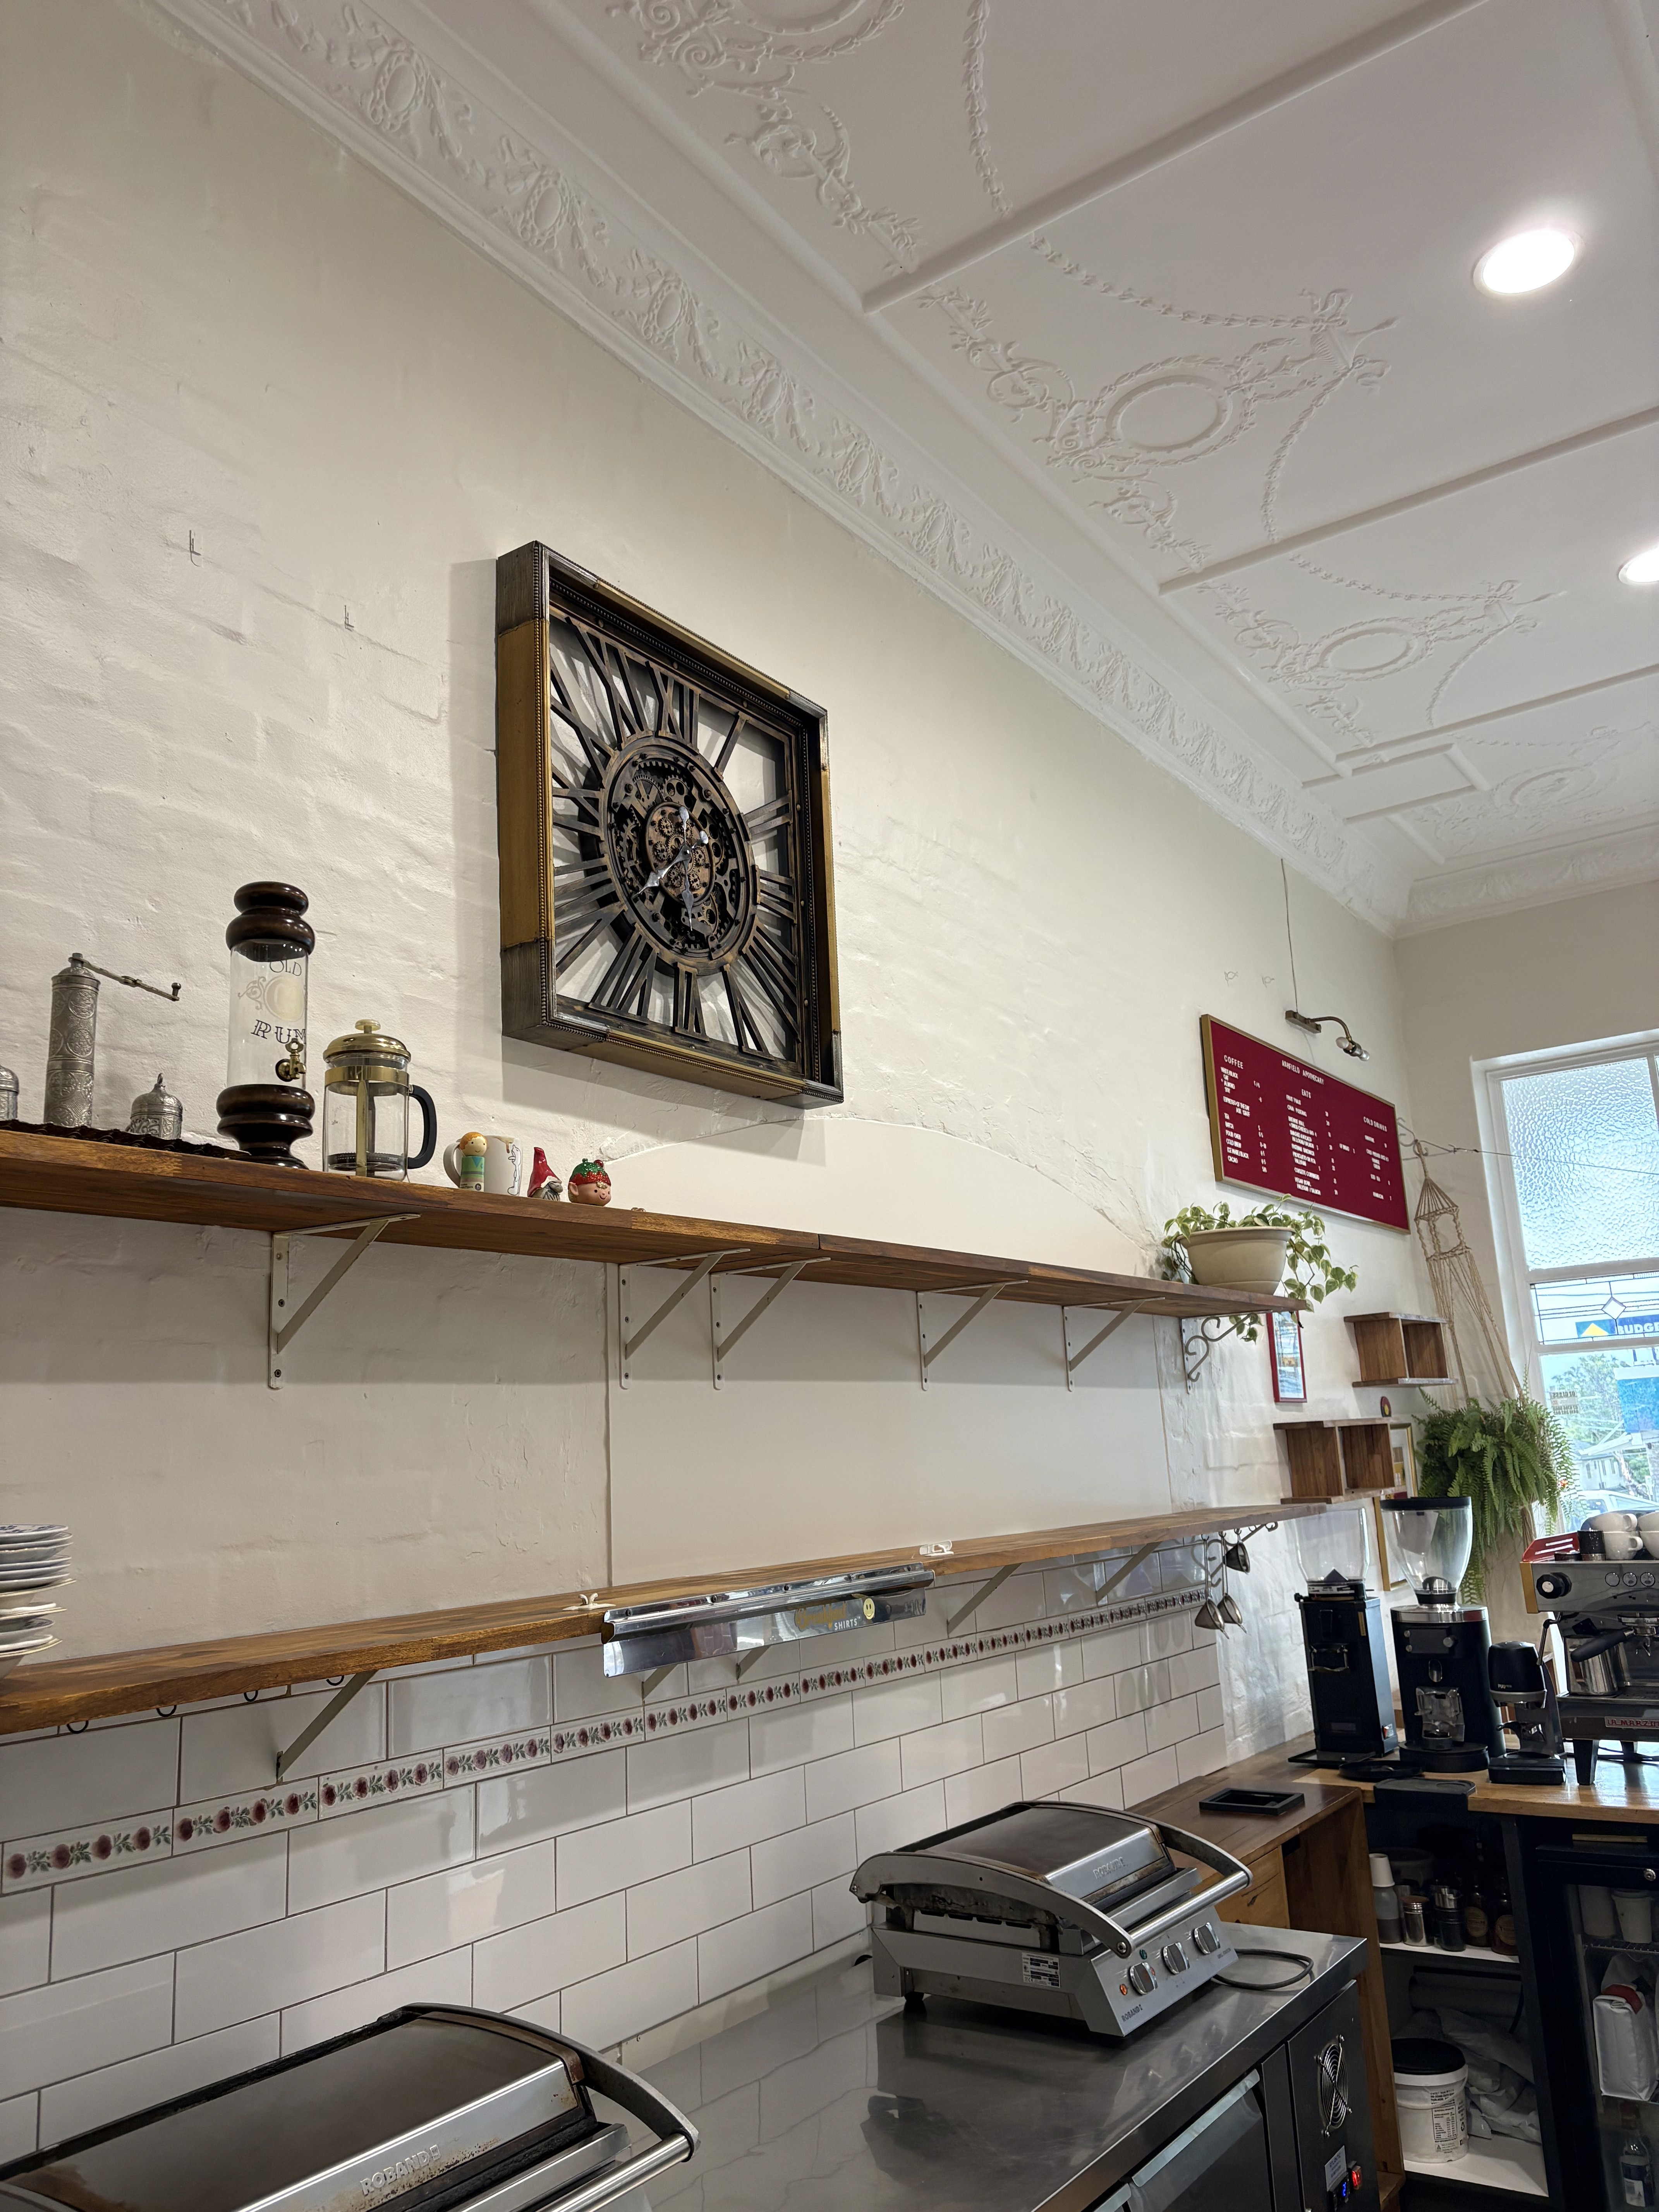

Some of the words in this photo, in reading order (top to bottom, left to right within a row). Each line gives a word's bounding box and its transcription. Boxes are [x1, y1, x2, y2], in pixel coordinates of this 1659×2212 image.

[270, 960, 302, 976] OLD
[250, 1019, 307, 1044] RUM
[1224, 1055, 1243, 1069] COFFEE
[1282, 1060, 1300, 1074] ASHFIELD
[1302, 1070, 1324, 1085] APOTHECARY
[1301, 1089, 1311, 1099] EATS
[1363, 1116, 1373, 1126] COLD
[1374, 1121, 1387, 1132] DRINKS
[1121, 2006, 1140, 2022] ROBAND
[360, 2150, 430, 2197] ROBAND
